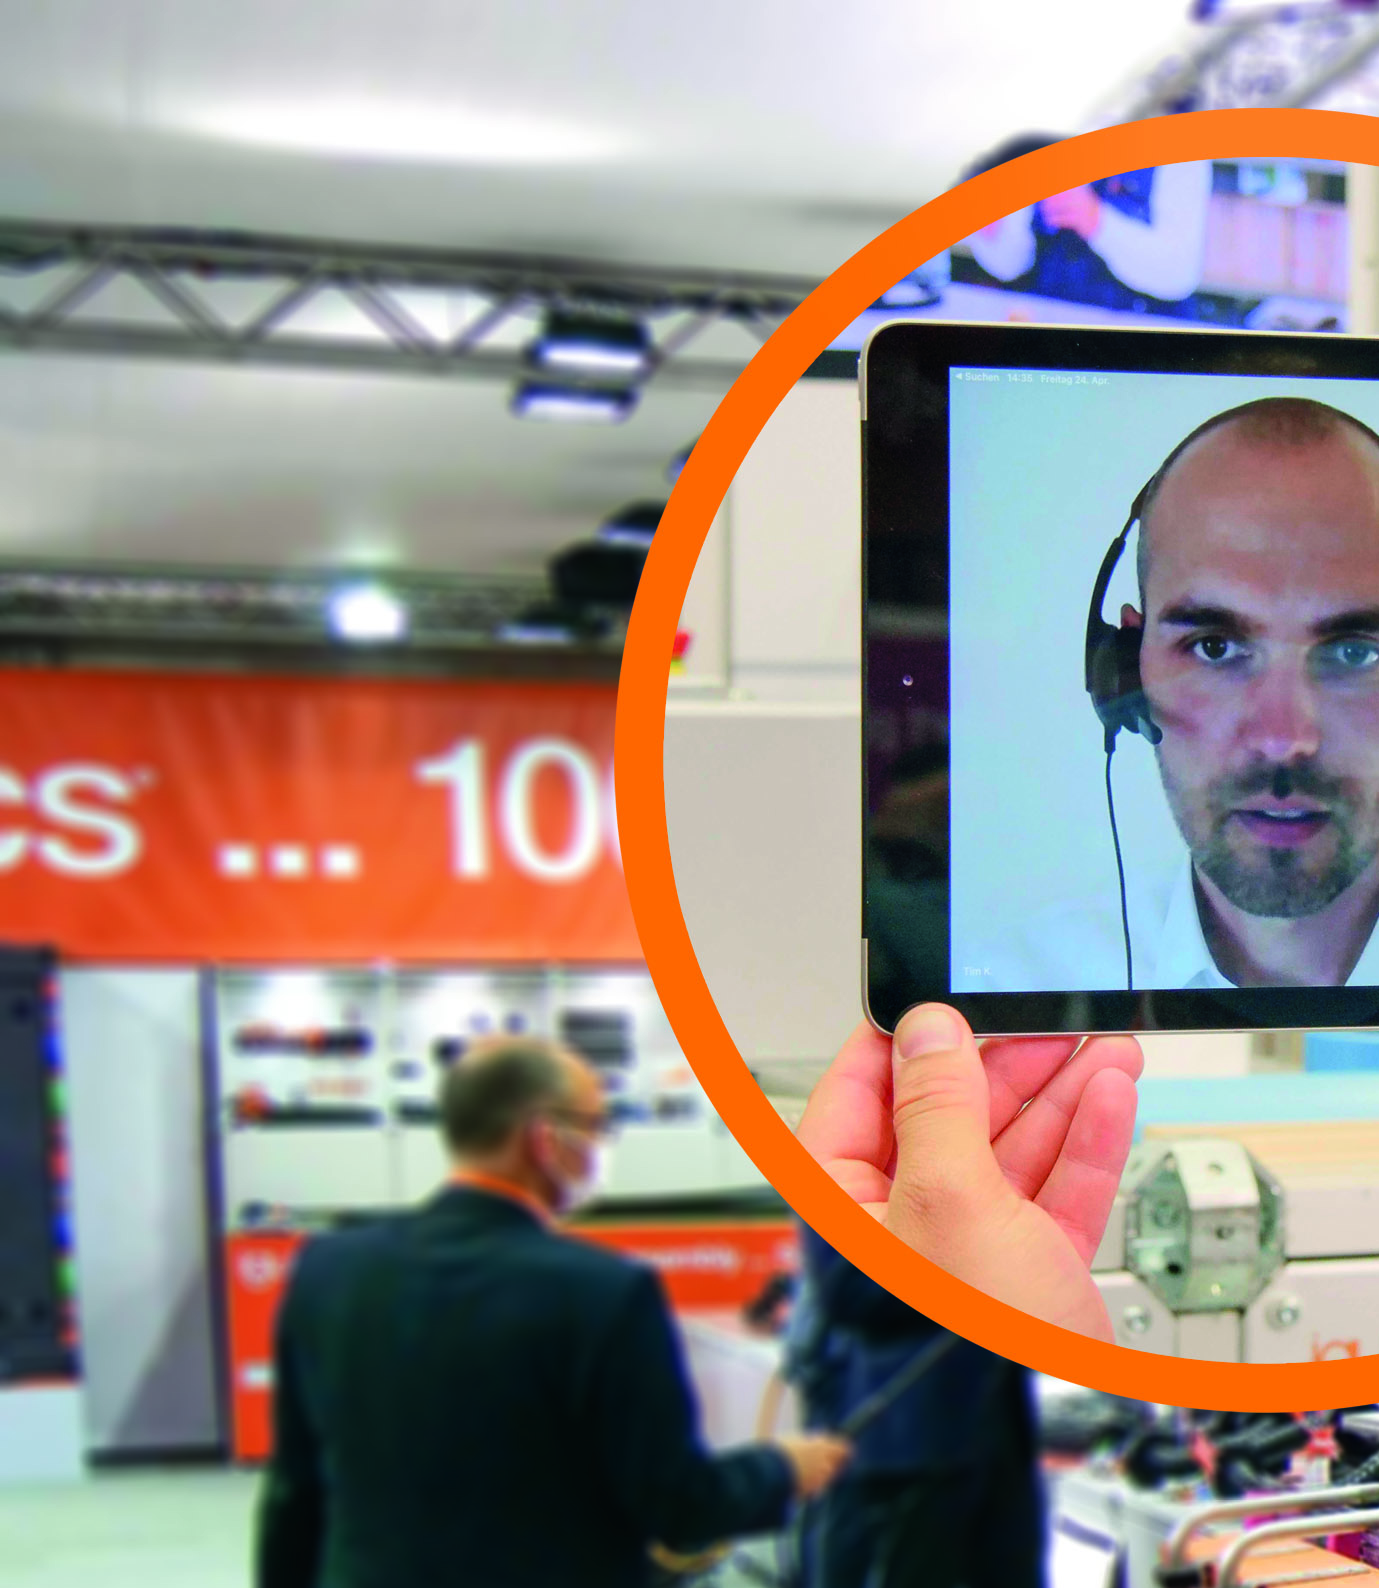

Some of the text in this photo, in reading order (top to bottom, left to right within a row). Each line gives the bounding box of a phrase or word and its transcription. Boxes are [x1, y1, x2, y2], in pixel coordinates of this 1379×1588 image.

[966, 373, 1110, 385] Suchen 14:35 Freitag 24. Apr.
[415, 737, 619, 881] 10
